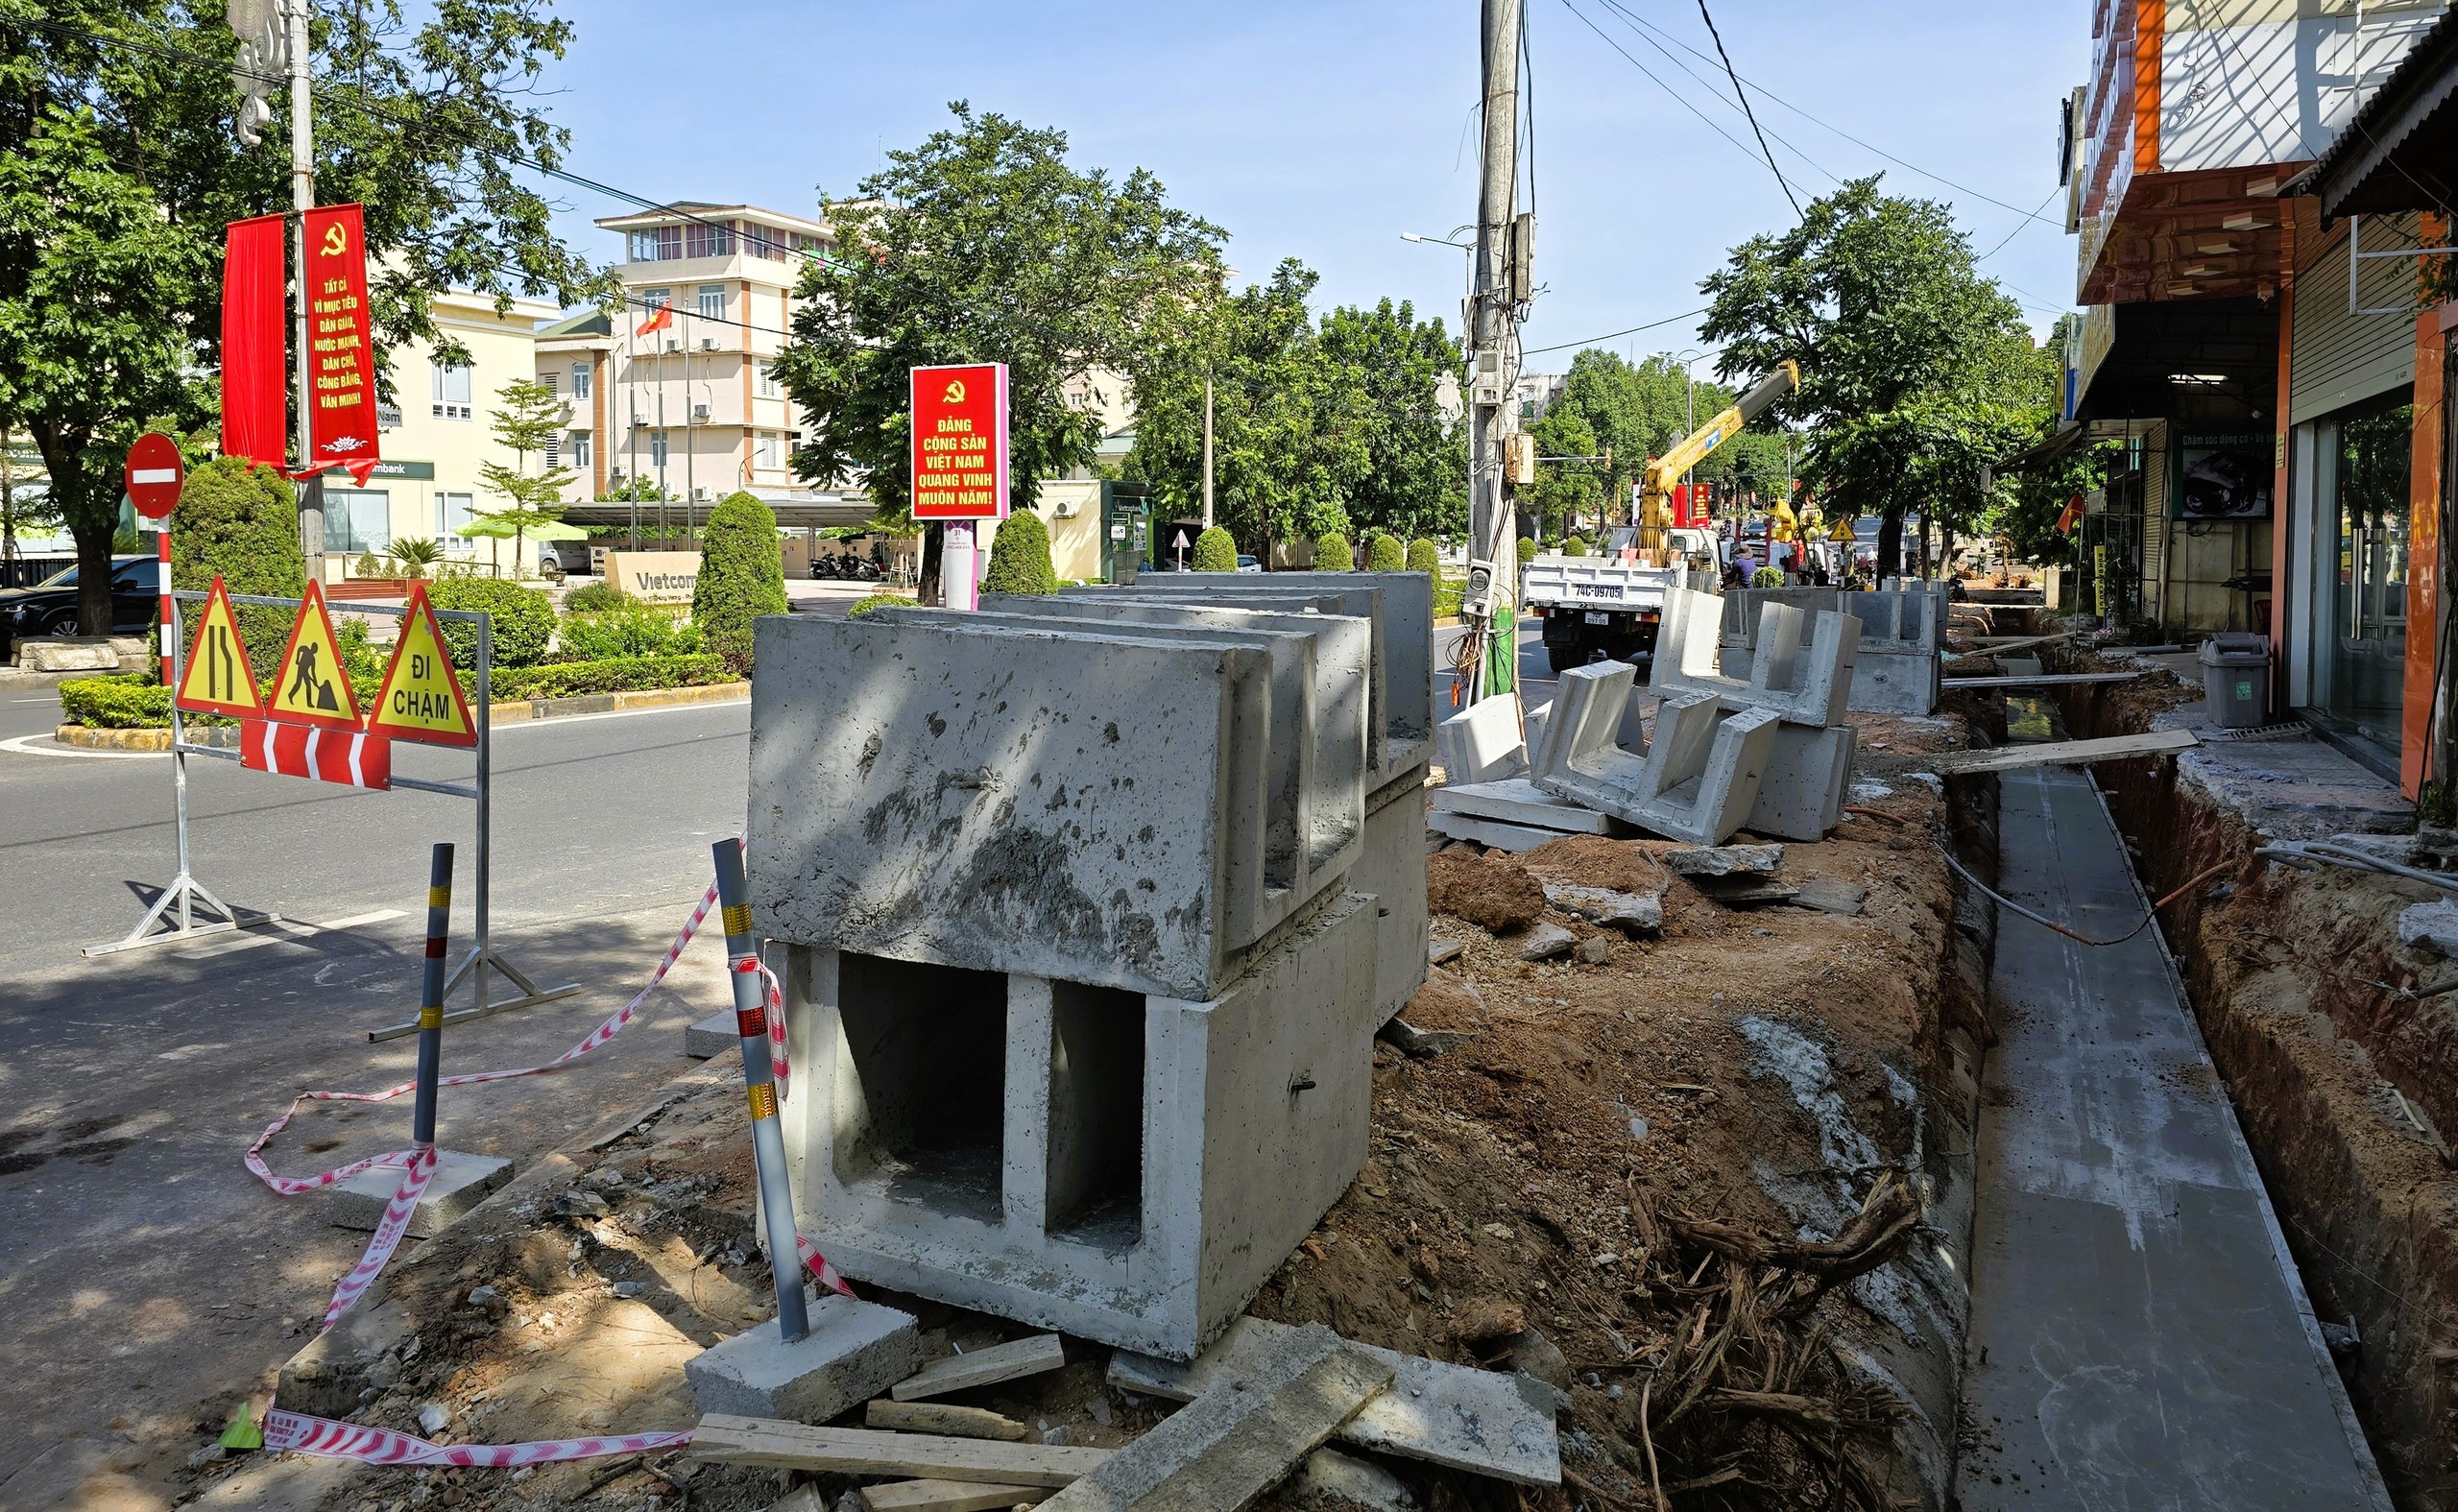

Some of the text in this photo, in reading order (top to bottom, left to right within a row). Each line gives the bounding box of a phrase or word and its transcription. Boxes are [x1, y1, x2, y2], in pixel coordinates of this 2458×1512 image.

[325, 276, 348, 294] TẤT CẢ
[314, 295, 357, 315] VÌ MỤC TIÊU
[320, 315, 356, 333] DÂN GIÀU,
[314, 335, 362, 351] NƯỚC MẠNH,
[323, 351, 357, 371] DÂN CHỦ,
[317, 371, 363, 390] CÔNG BẰNG,
[321, 392, 361, 408] VĂN MINH!
[377, 410, 400, 422] Nam
[937, 415, 972, 433] ĐẢNG
[924, 433, 987, 453] CỘNG SẢN
[926, 453, 984, 471] VIỆT NAM
[918, 473, 993, 489] QUANG VINH
[918, 489, 993, 505] MUÔN NĂM!
[1576, 585, 1621, 598] 74C-09705
[411, 654, 430, 681] ĐI
[394, 687, 449, 724] CHẬM
